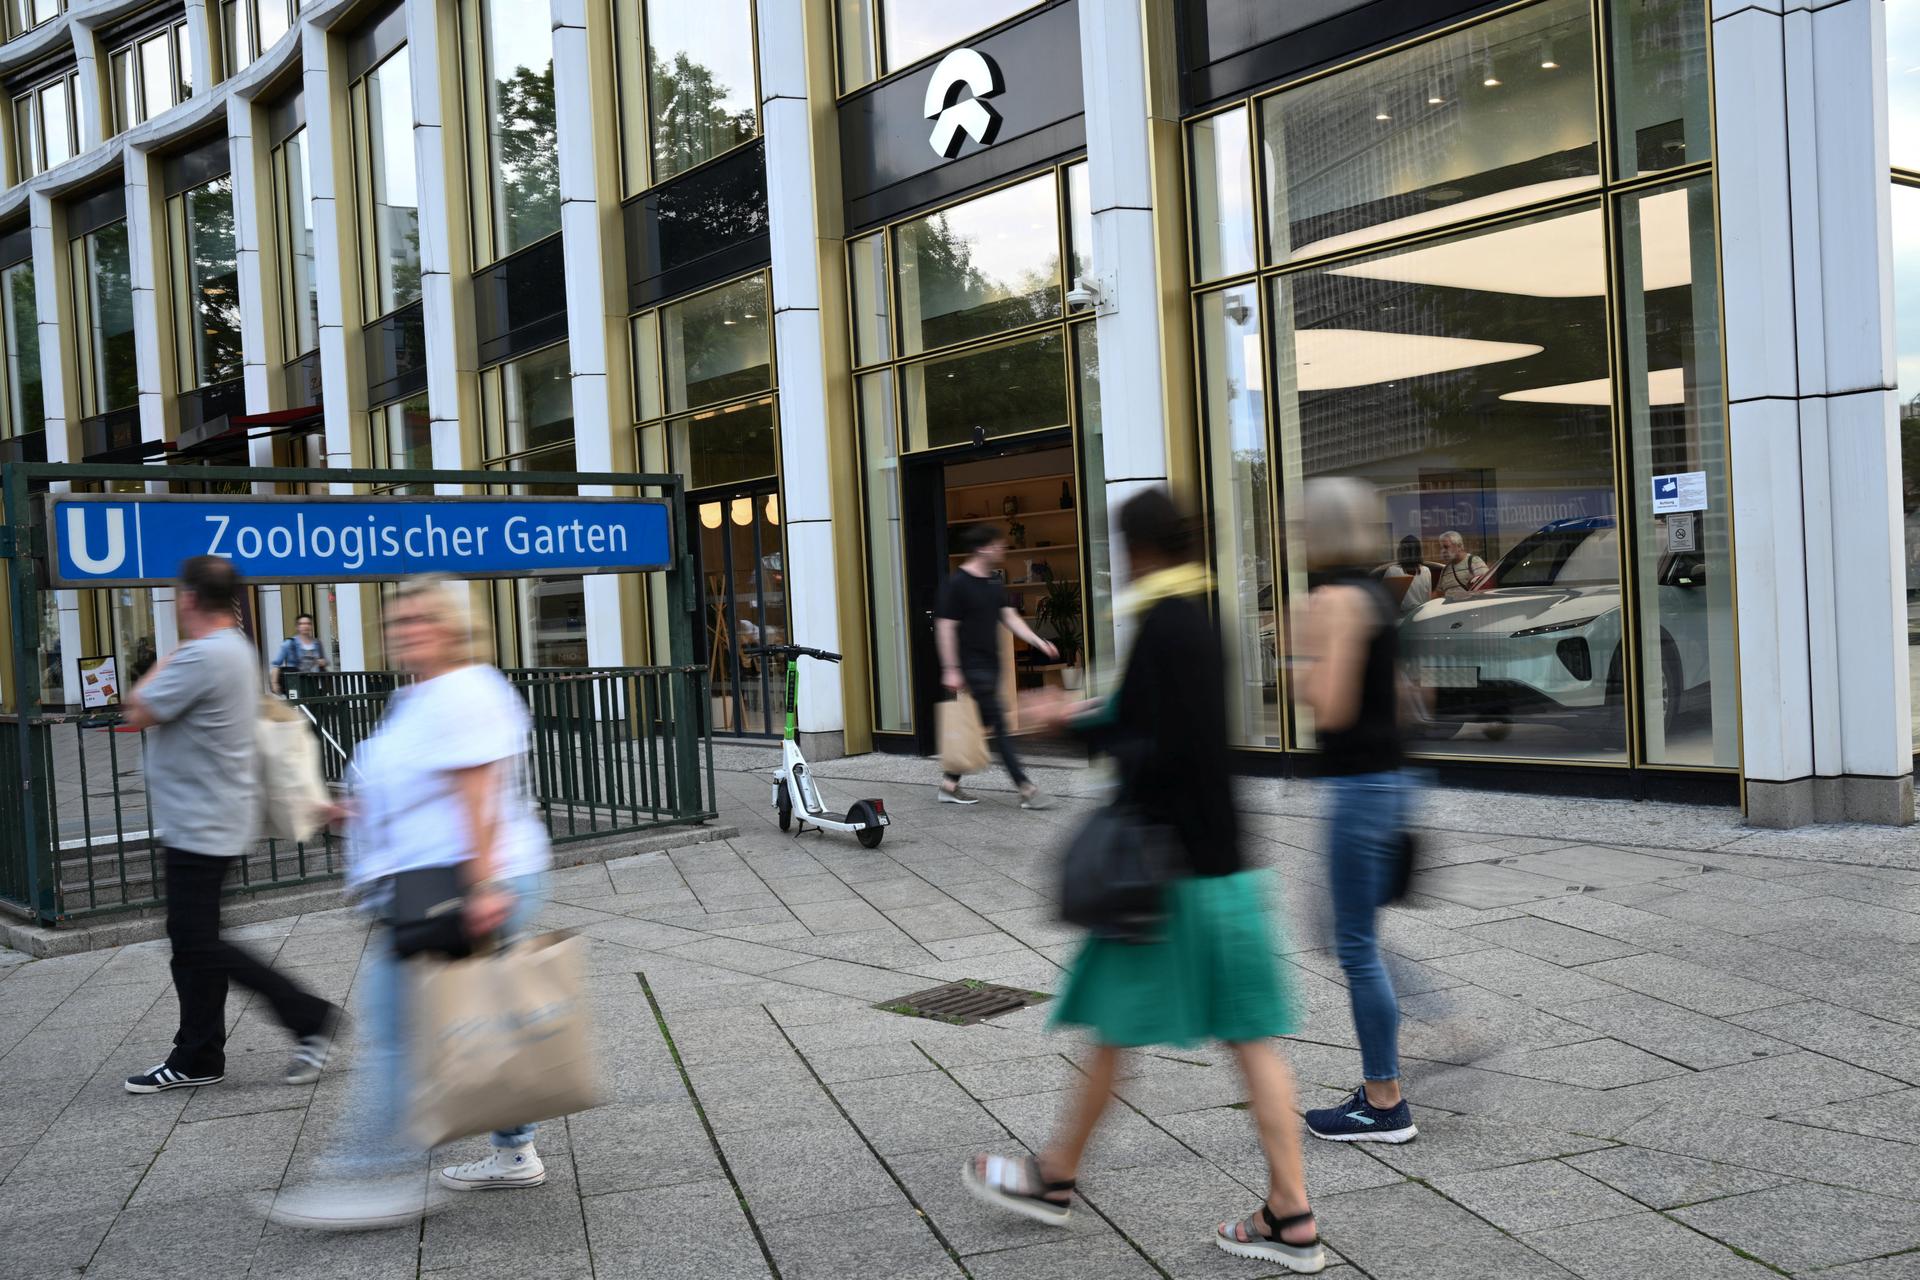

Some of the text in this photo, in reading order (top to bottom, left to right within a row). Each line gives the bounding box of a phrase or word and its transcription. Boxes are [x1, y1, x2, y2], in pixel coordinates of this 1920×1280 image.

[66, 507, 628, 575] U Zoologischer Garten
